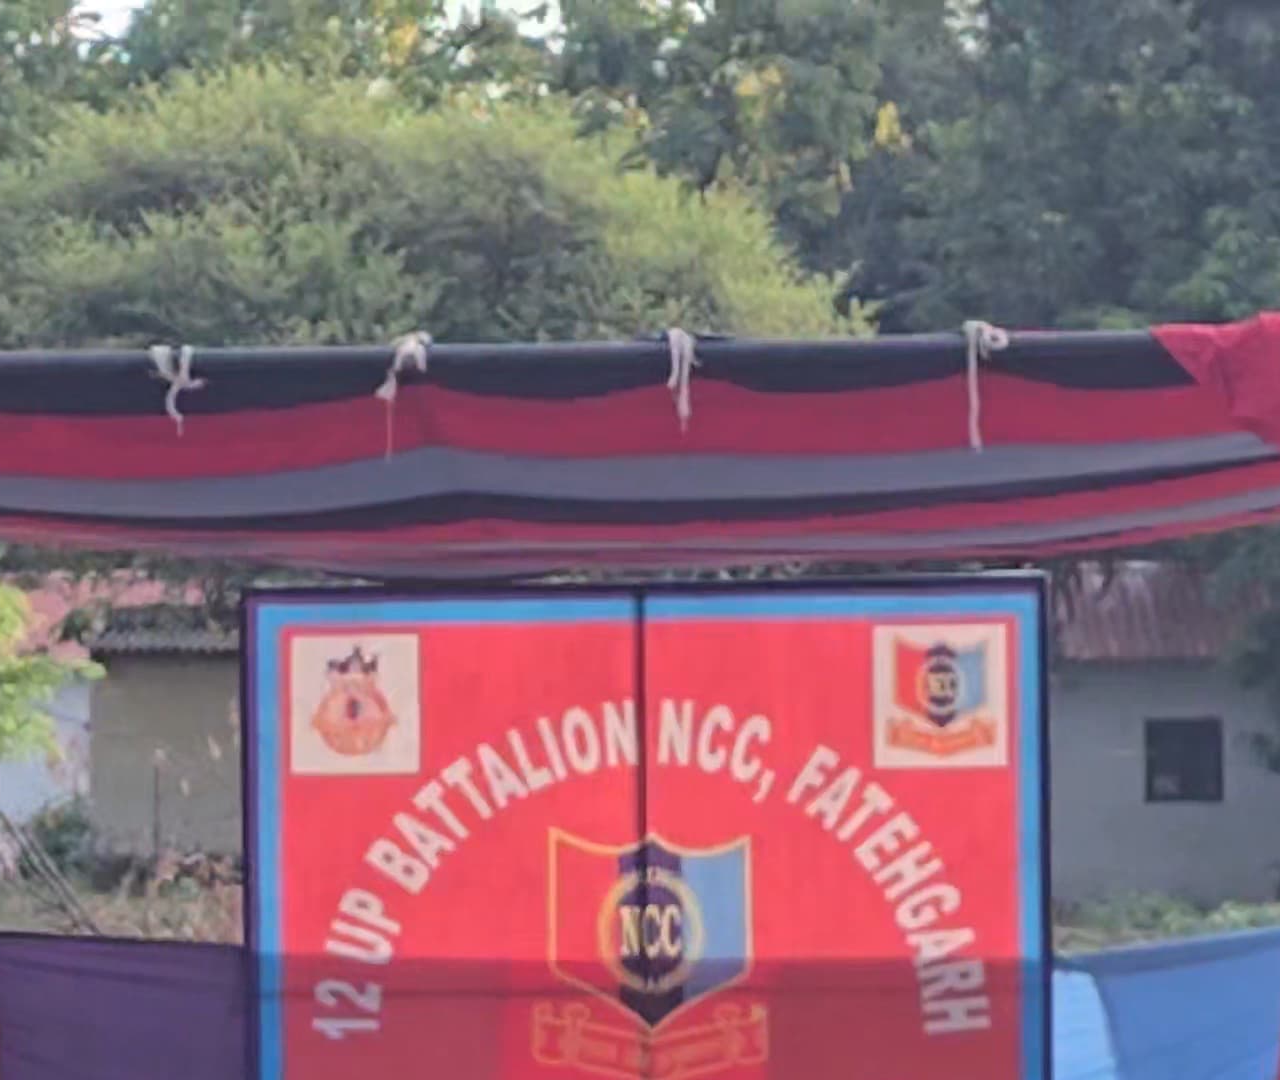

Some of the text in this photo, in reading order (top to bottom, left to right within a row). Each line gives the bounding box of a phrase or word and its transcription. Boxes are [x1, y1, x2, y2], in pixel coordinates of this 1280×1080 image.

[311, 697, 992, 1041] 12 UP BATTALION NCC, FATEHGARH
[619, 903, 683, 960] NCC
